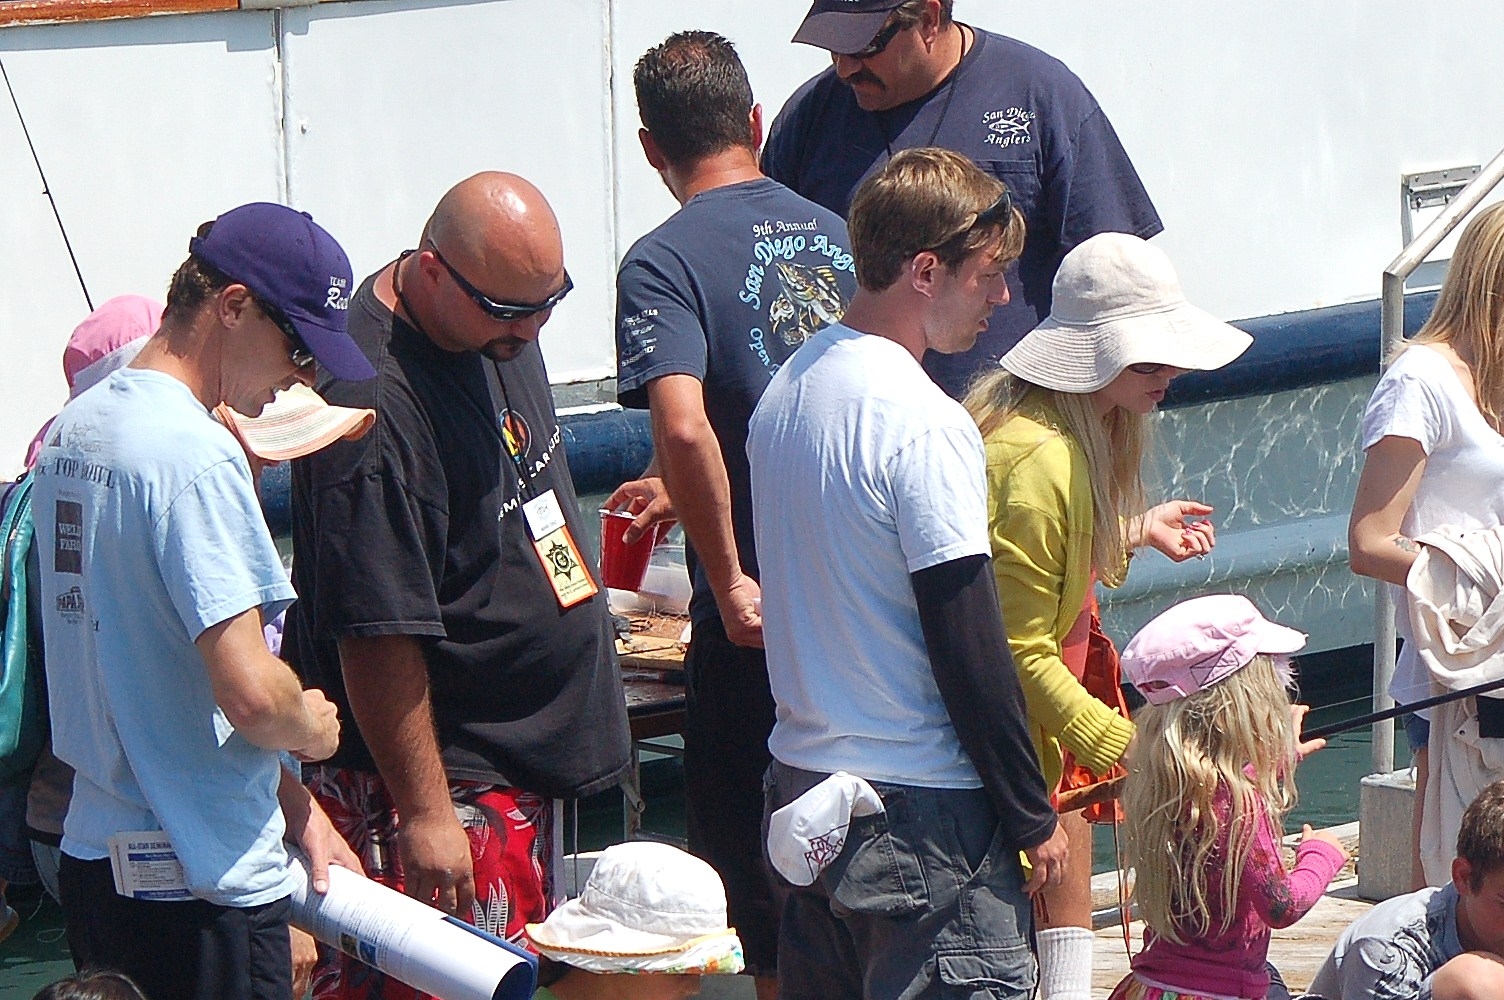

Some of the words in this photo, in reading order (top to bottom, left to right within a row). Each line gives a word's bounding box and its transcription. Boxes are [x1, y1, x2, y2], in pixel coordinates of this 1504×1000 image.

[982, 110, 1004, 124] San
[983, 133, 1031, 149] Anglers
[753, 220, 773, 239] 9th
[775, 218, 818, 234] Annual
[738, 263, 766, 311] San
[753, 235, 806, 267] Diego
[749, 327, 772, 367] Open
